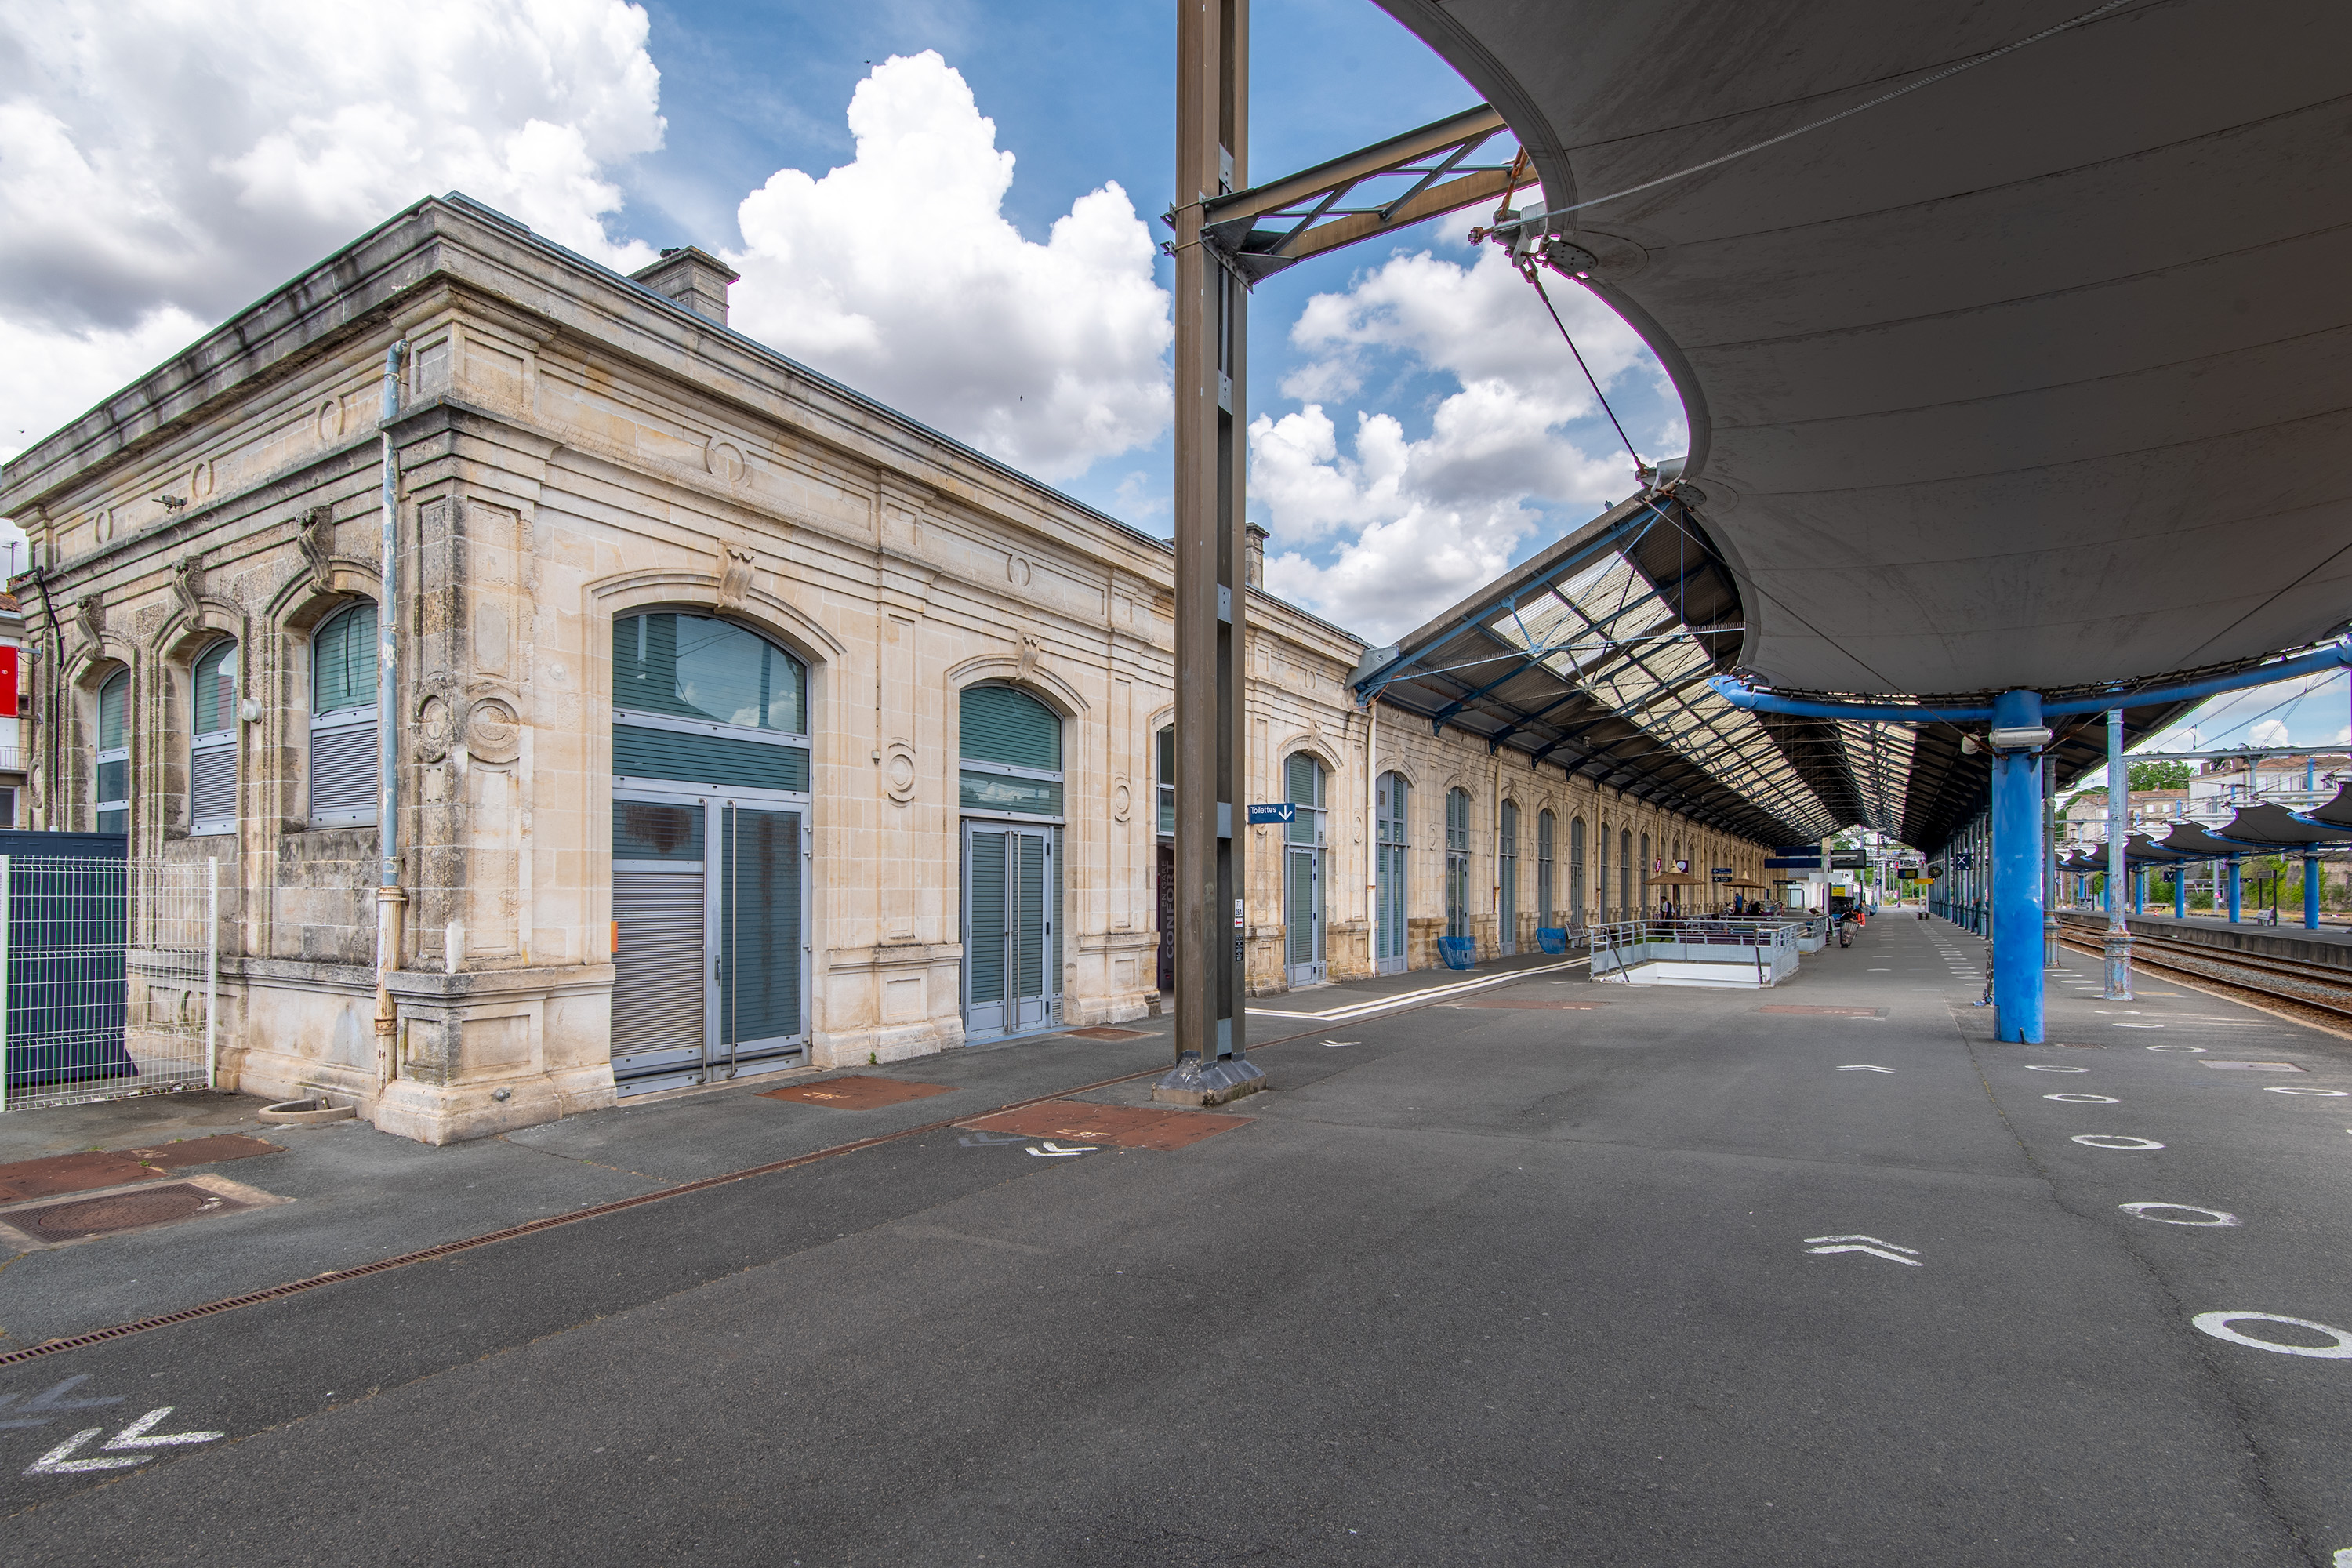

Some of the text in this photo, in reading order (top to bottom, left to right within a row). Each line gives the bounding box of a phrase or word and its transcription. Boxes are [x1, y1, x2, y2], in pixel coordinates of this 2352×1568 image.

[1250, 806, 1277, 815] Toilettes
[1161, 893, 1167, 907] EN
[1166, 860, 1174, 959] CONFORT
